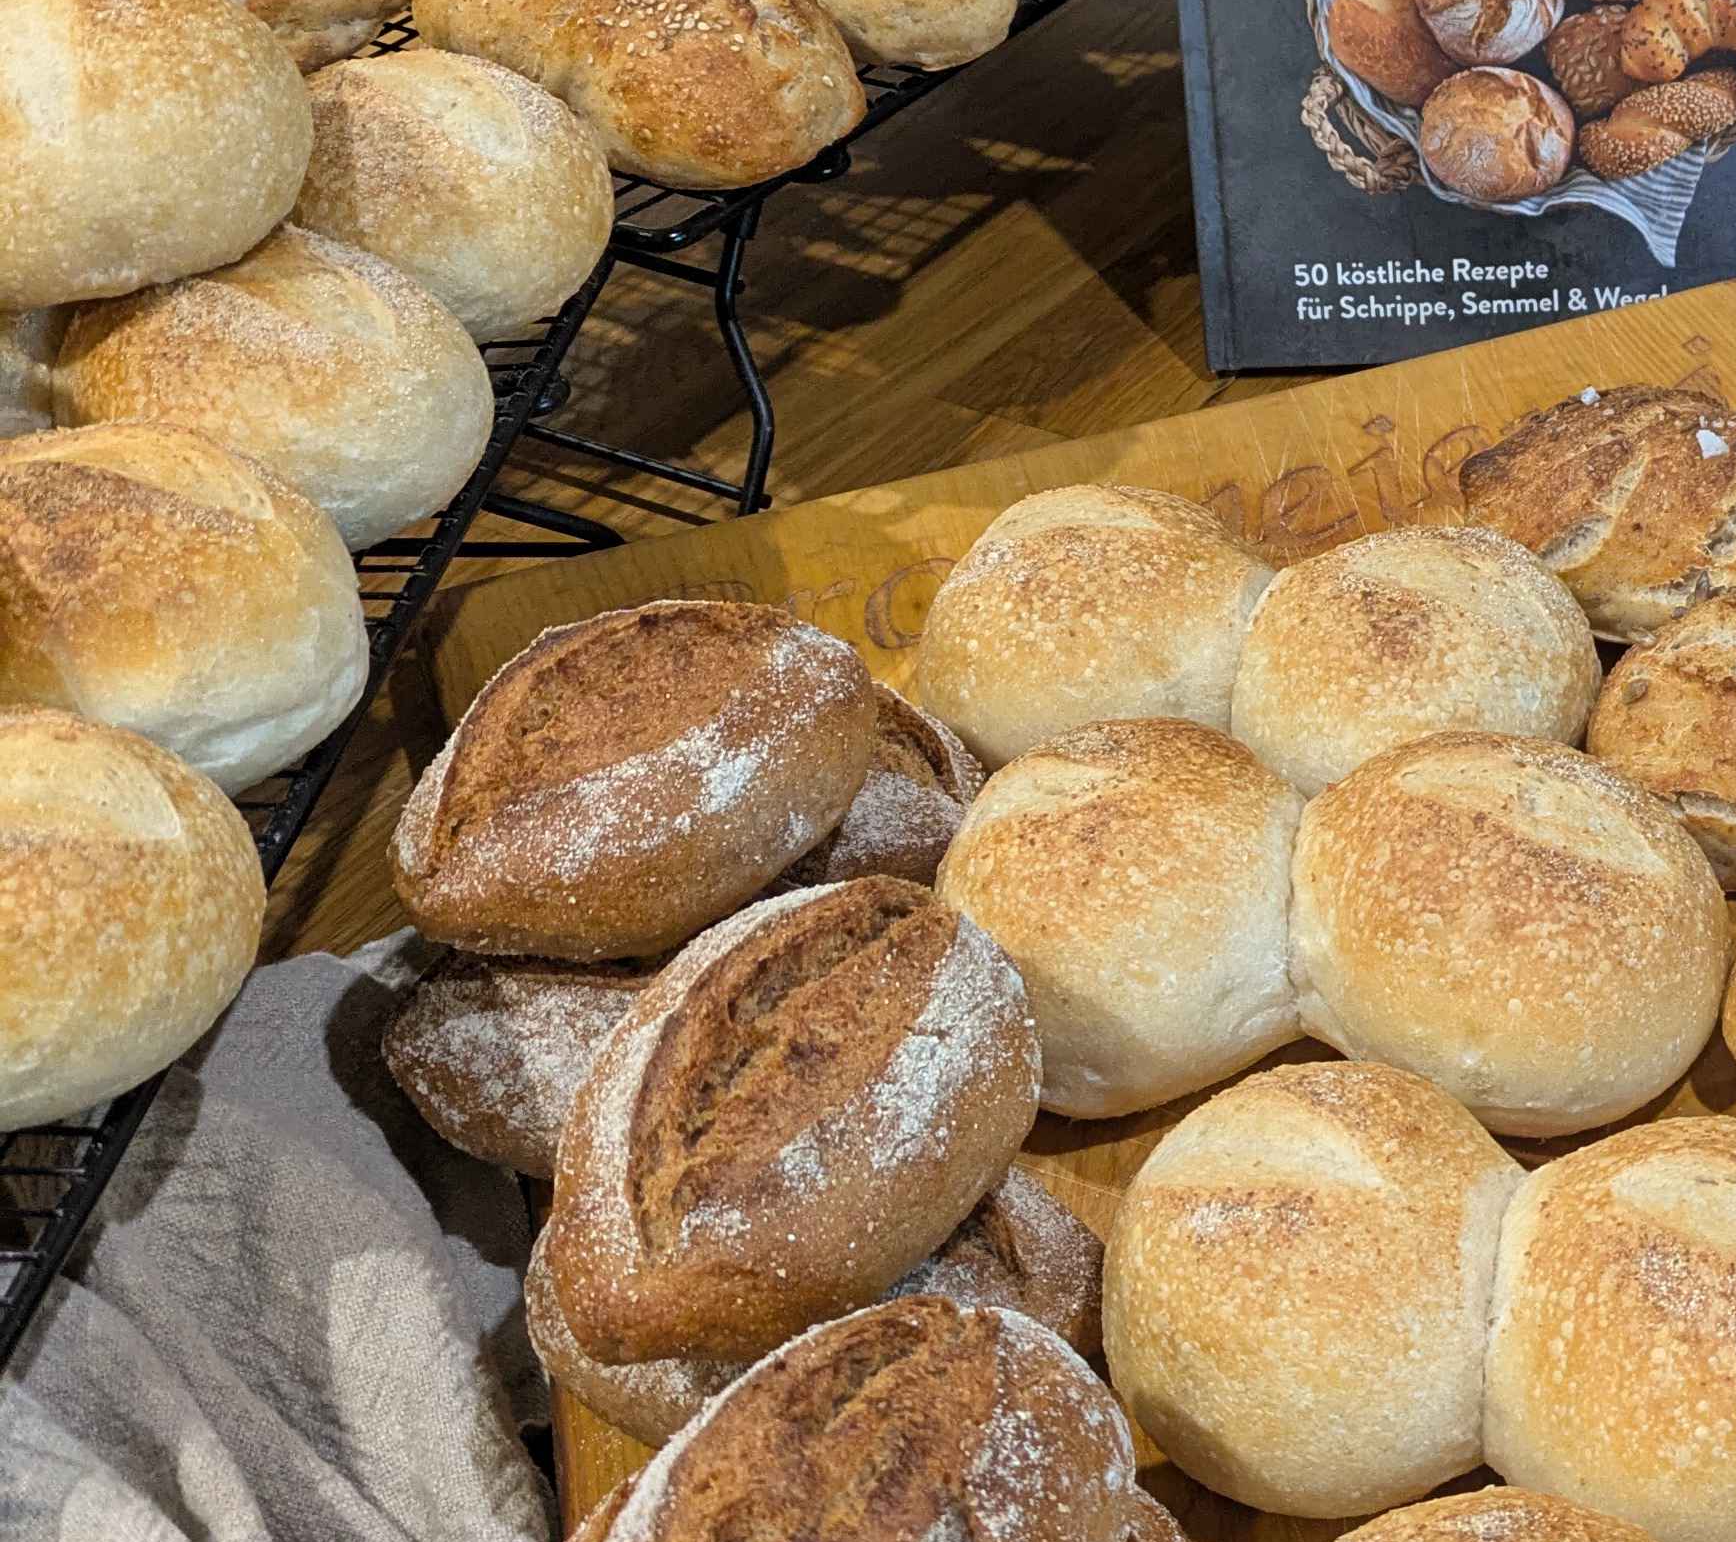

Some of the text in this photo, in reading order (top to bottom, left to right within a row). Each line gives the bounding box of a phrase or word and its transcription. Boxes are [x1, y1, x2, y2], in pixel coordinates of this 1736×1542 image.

[1294, 258, 1550, 290] 50 köstliche Rezepte
[1296, 294, 1334, 323] für
[1340, 292, 1457, 327] Schrippe,
[1462, 289, 1559, 315] Semmel
[1568, 288, 1588, 311] &
